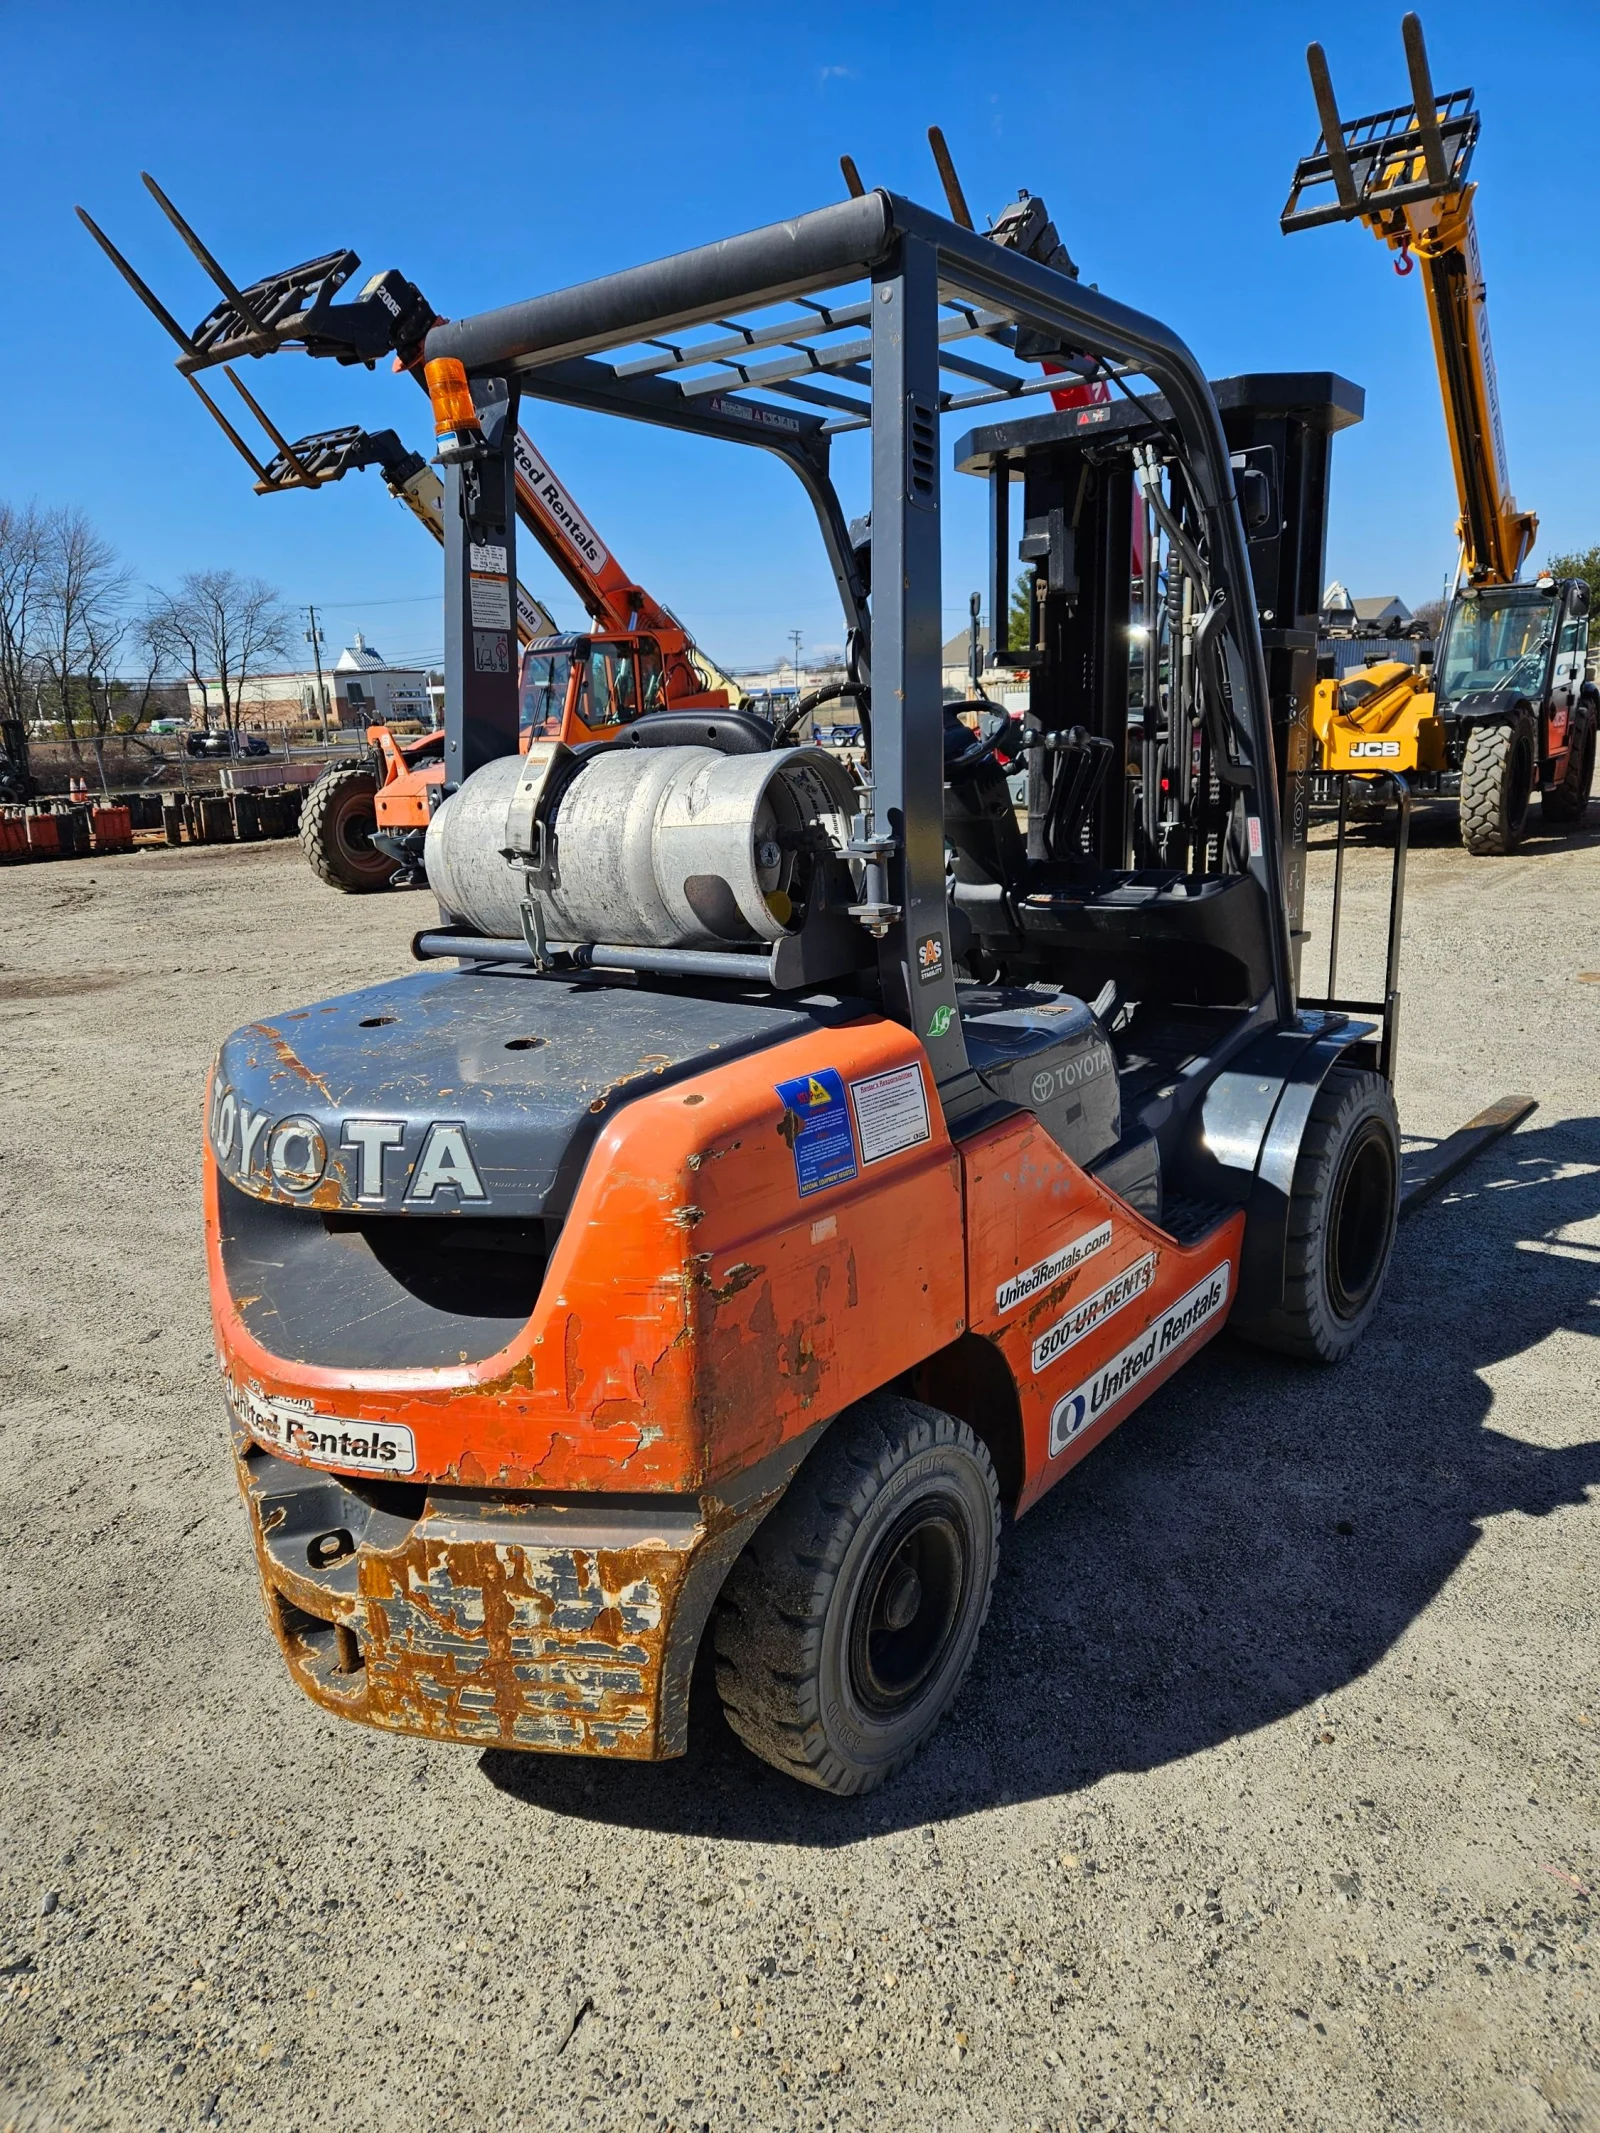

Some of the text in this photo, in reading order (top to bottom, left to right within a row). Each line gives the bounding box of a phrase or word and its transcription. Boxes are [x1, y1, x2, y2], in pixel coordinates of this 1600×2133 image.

[376, 285, 402, 317] 2005
[514, 438, 598, 561] ted Rentals
[516, 598, 536, 625] tals
[1350, 741, 1400, 757] JCB
[1292, 704, 1310, 850] TOYOTA
[918, 939, 942, 967] SAS
[860, 1071, 913, 1094] Renter's Responsibilities
[1055, 1048, 1110, 1089] TOYOTA
[210, 1075, 491, 1202] TOYOTA
[999, 1230, 1111, 1309] UnitedRentals.com
[1090, 1281, 1222, 1413] United Rentals
[285, 1418, 397, 1461] Rentals
[864, 1453, 948, 1532] MAGNUM
